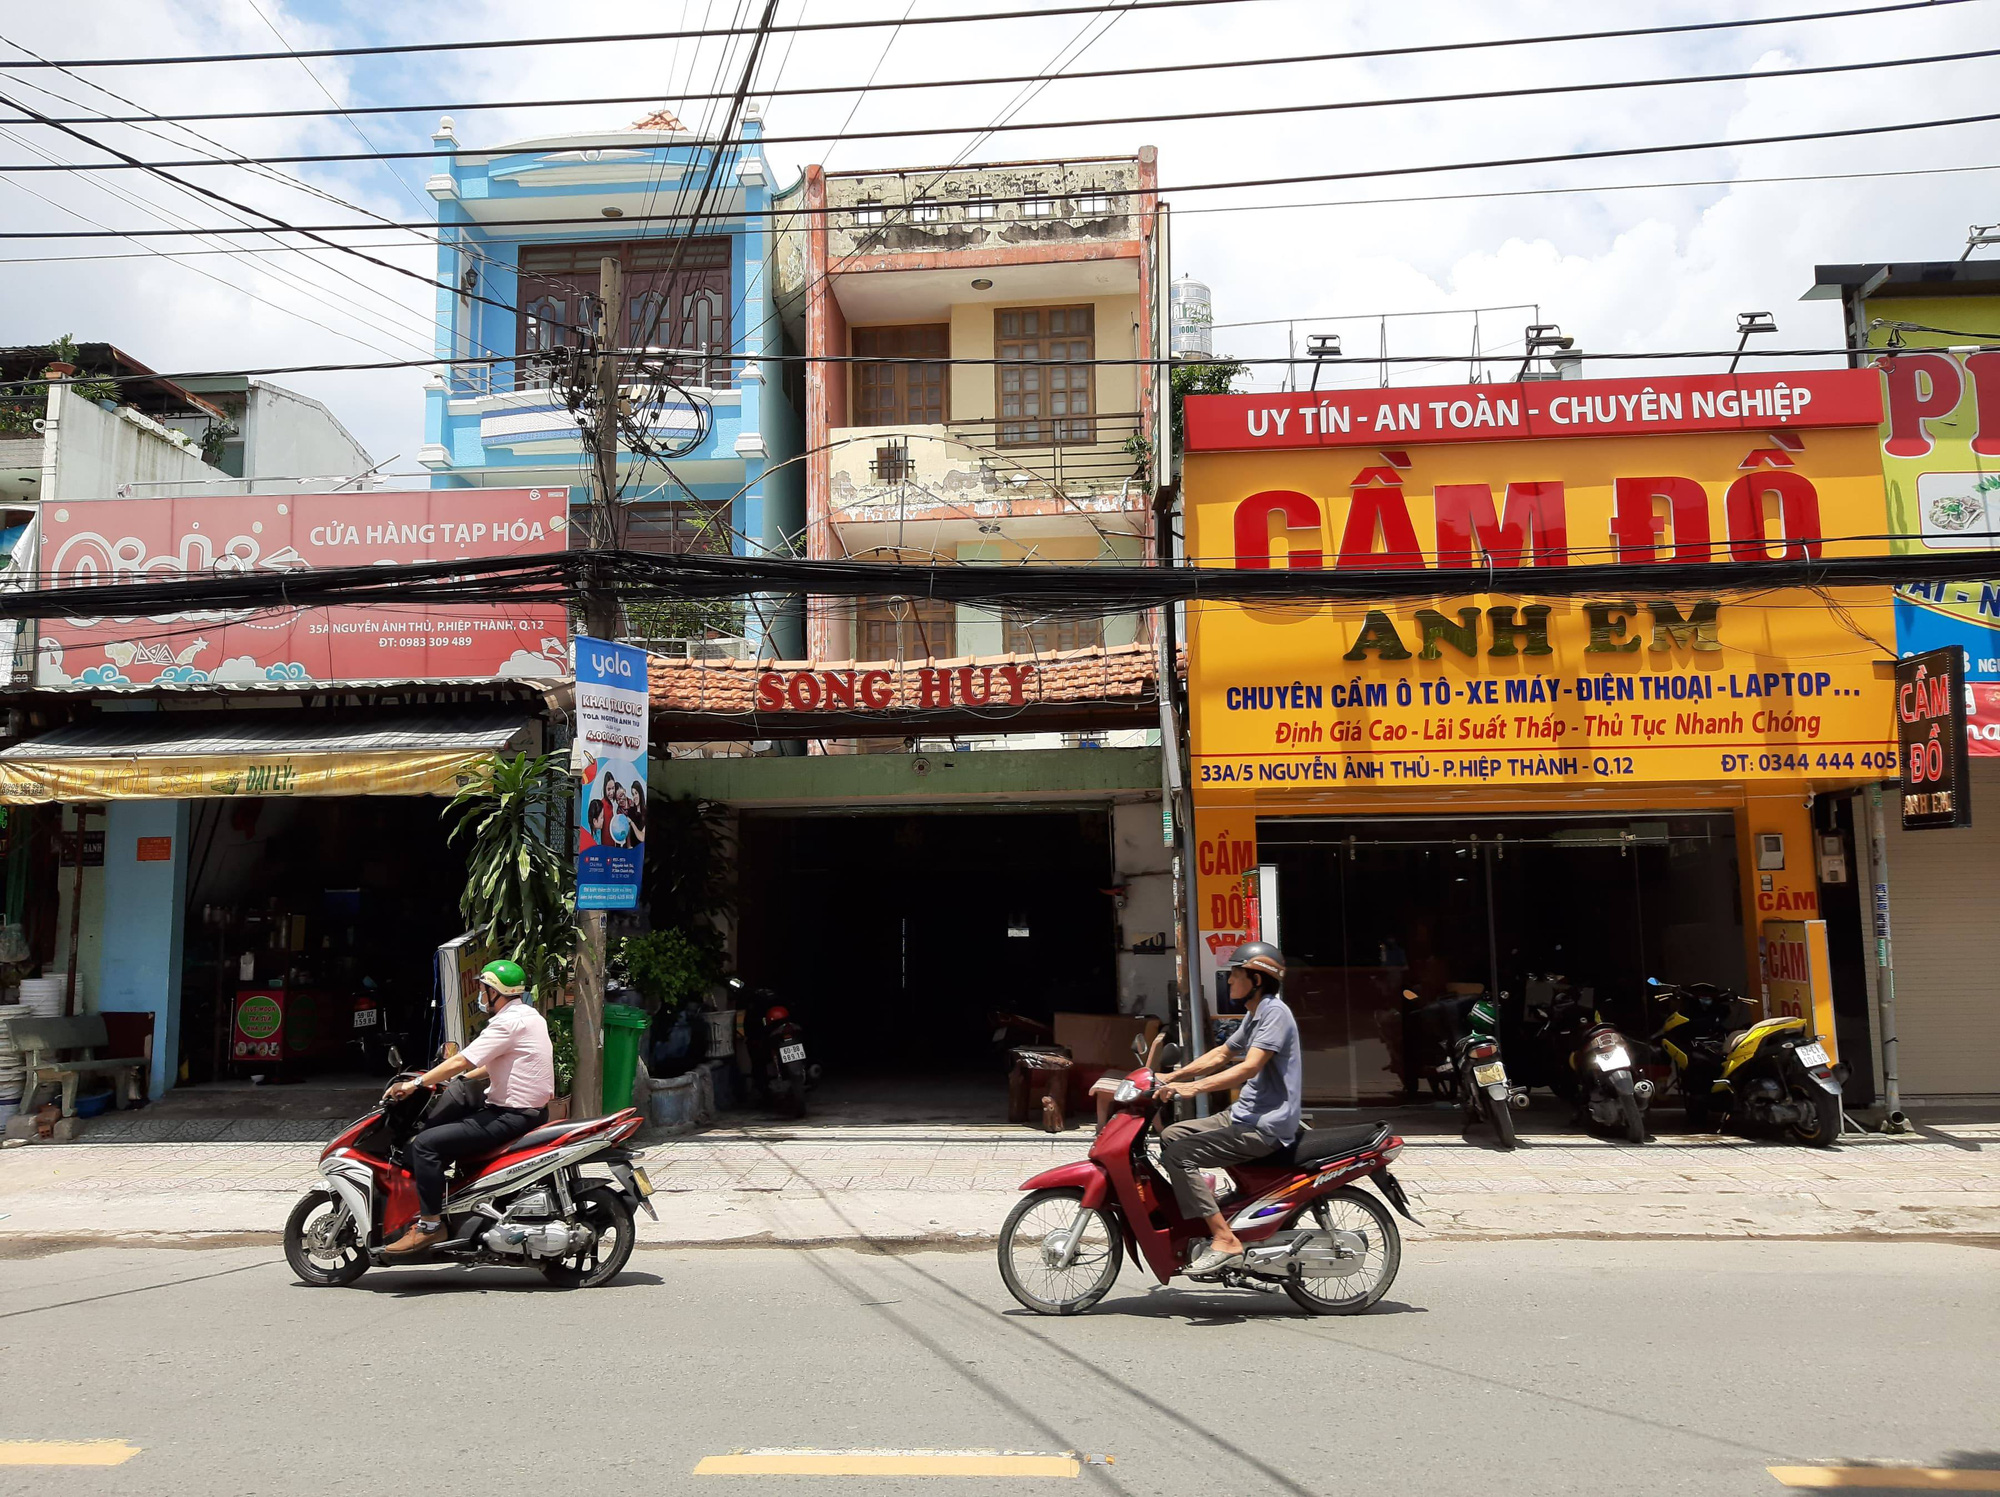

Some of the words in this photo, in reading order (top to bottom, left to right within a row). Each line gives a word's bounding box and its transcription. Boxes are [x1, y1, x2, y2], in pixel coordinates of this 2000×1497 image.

[1247, 408, 1290, 437] UY
[1299, 400, 1350, 434] TÍN
[1374, 403, 1420, 431] AN
[1428, 393, 1519, 429] TOÀN
[1550, 387, 1682, 424] CHUYÊN
[1692, 381, 1812, 422] NGHIỆP
[1234, 450, 1568, 569] CẦM
[1609, 434, 1822, 563] ĐỒ
[309, 520, 360, 546] CỬA
[366, 521, 435, 544] HÀNG
[440, 523, 486, 548] TẠP
[493, 518, 545, 541] HÓA
[309, 624, 329, 634] 35A
[332, 620, 380, 633] NGUYỄN
[382, 620, 406, 632] ẢNH
[408, 619, 434, 633] THỦ,
[519, 620, 544, 631] Q.12
[379, 637, 397, 647] ĐT:
[399, 637, 427, 647] 0983
[429, 637, 449, 647] 309
[451, 637, 473, 646] 489
[1343, 604, 1553, 660] ANH
[1584, 600, 1722, 653] EM
[592, 651, 631, 678] yola
[758, 669, 895, 711] SONG
[918, 665, 1035, 709] HUY
[1226, 682, 1322, 710] CHUYÊN
[1331, 676, 1387, 708] CẦM
[1396, 678, 1411, 706] Ô
[1900, 664, 1950, 723] CẦM
[583, 712, 599, 721] YOLA
[1275, 721, 1322, 748] Định
[1330, 719, 1362, 741] Giá
[1368, 720, 1407, 741] Cao
[1424, 718, 1453, 740] Lãi
[1459, 714, 1506, 740] Suất
[1513, 712, 1566, 741] Thấp
[1584, 712, 1623, 737] Thủ
[1631, 715, 1666, 741] Tục
[1675, 711, 1743, 735] Nhanh
[1752, 710, 1821, 738] Chóng
[1200, 764, 1253, 782] 33A/5
[1259, 755, 1337, 781] NGUYỄN
[1343, 755, 1383, 779] ẢNH
[1507, 753, 1577, 778] THÀNH
[1593, 757, 1634, 777] Q.12
[1721, 754, 1755, 772] ĐT:
[1759, 754, 1809, 772] 0344
[1816, 753, 1855, 771] 444
[1860, 751, 1897, 770] 405
[1910, 723, 1943, 783] ĐỒ
[101, 762, 150, 794] HÓA
[156, 766, 203, 794] 35A
[246, 765, 272, 795] ĐẠI
[1904, 793, 1929, 815] ANH
[1932, 791, 1953, 813] EM
[1200, 829, 1254, 876] CẦM
[1211, 882, 1245, 929] ĐỒ
[1758, 886, 1816, 911] CẦM
[1769, 929, 1807, 982] CẦM
